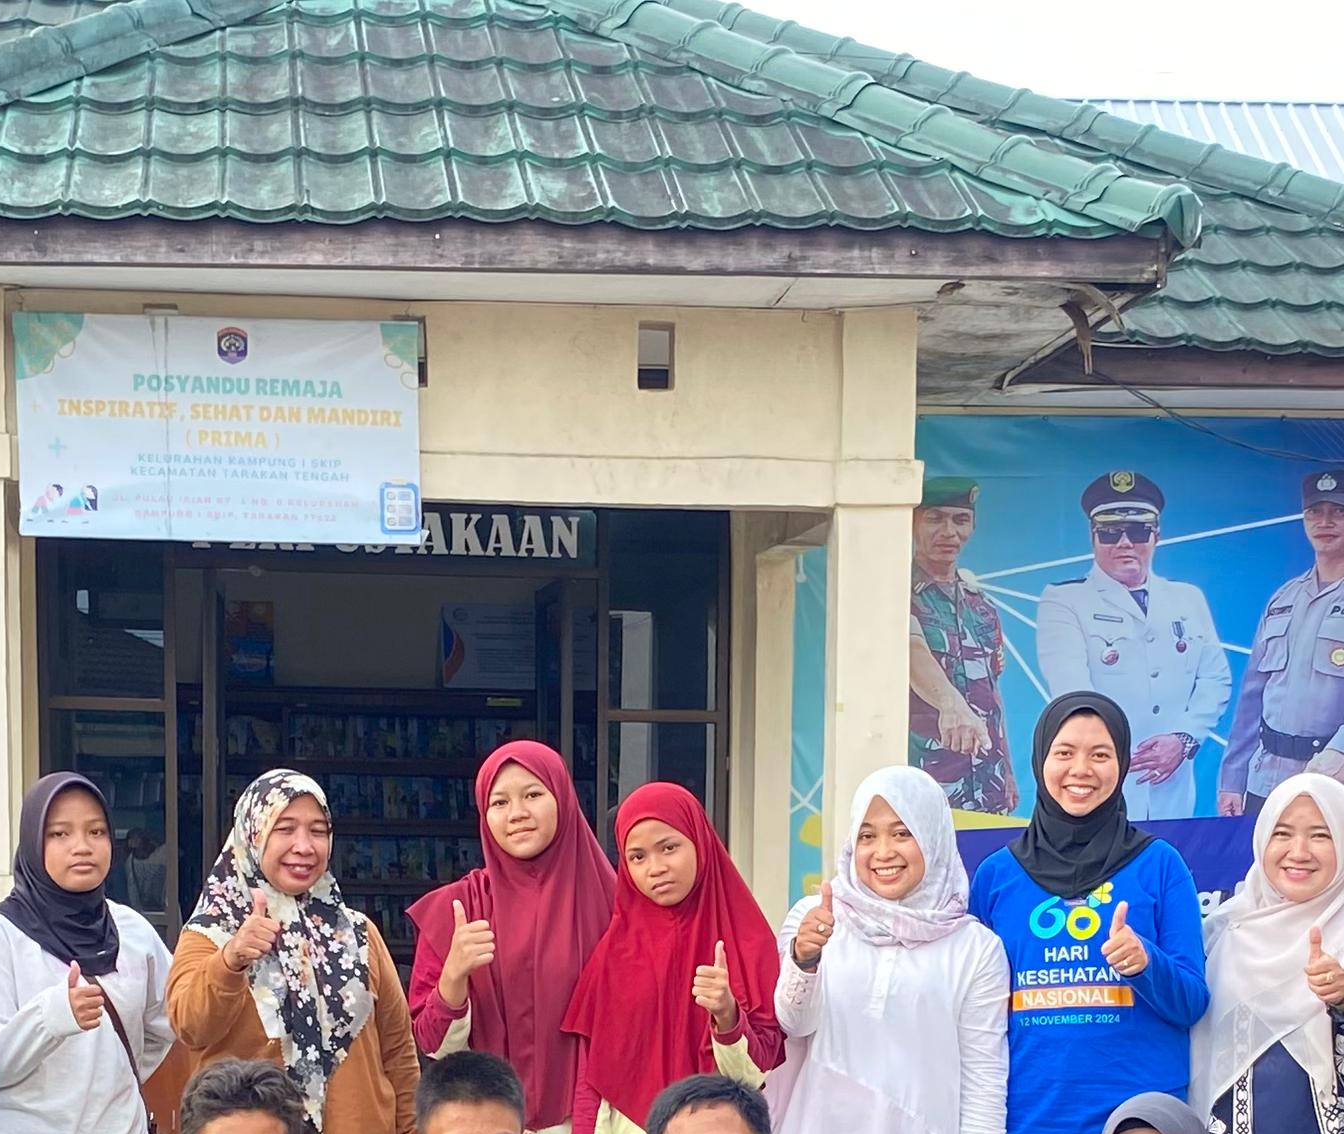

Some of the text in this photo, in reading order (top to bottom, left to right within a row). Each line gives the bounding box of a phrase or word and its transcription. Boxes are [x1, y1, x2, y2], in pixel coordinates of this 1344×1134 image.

[132, 374, 343, 398] POSYANDU REMAJA
[191, 403, 254, 422] SEHAT
[259, 406, 302, 423] DAN
[307, 407, 403, 427] MANDIRI
[198, 430, 268, 449] PRIMA
[138, 453, 222, 465] KELURAHAN
[228, 456, 296, 468] KAMPUNG
[311, 459, 342, 468] SKIP
[130, 466, 350, 482] KECAMATAN TARAKAN TENGAH
[1044, 945, 1088, 962] HARI
[1017, 966, 1120, 986] KESEHATAN
[1022, 987, 1115, 1006] NASIONAL
[1019, 1013, 1120, 1026] 12 NOVEMBER 2024
